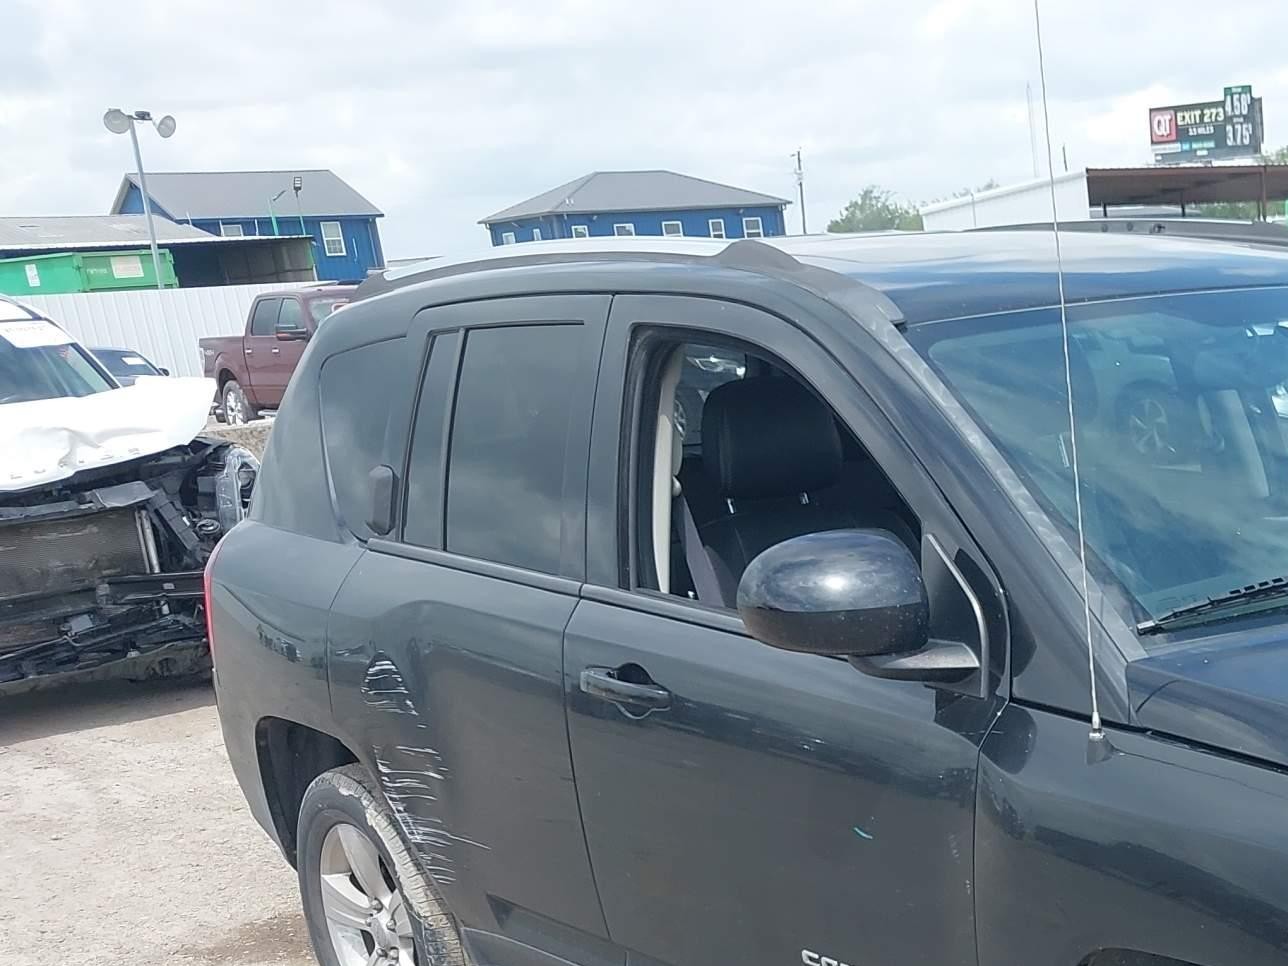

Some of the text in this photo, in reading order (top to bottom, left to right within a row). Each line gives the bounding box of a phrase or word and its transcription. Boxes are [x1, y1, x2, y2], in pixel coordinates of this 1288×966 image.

[1153, 114, 1172, 138] QT
[1176, 107, 1225, 126] EXIT 273
